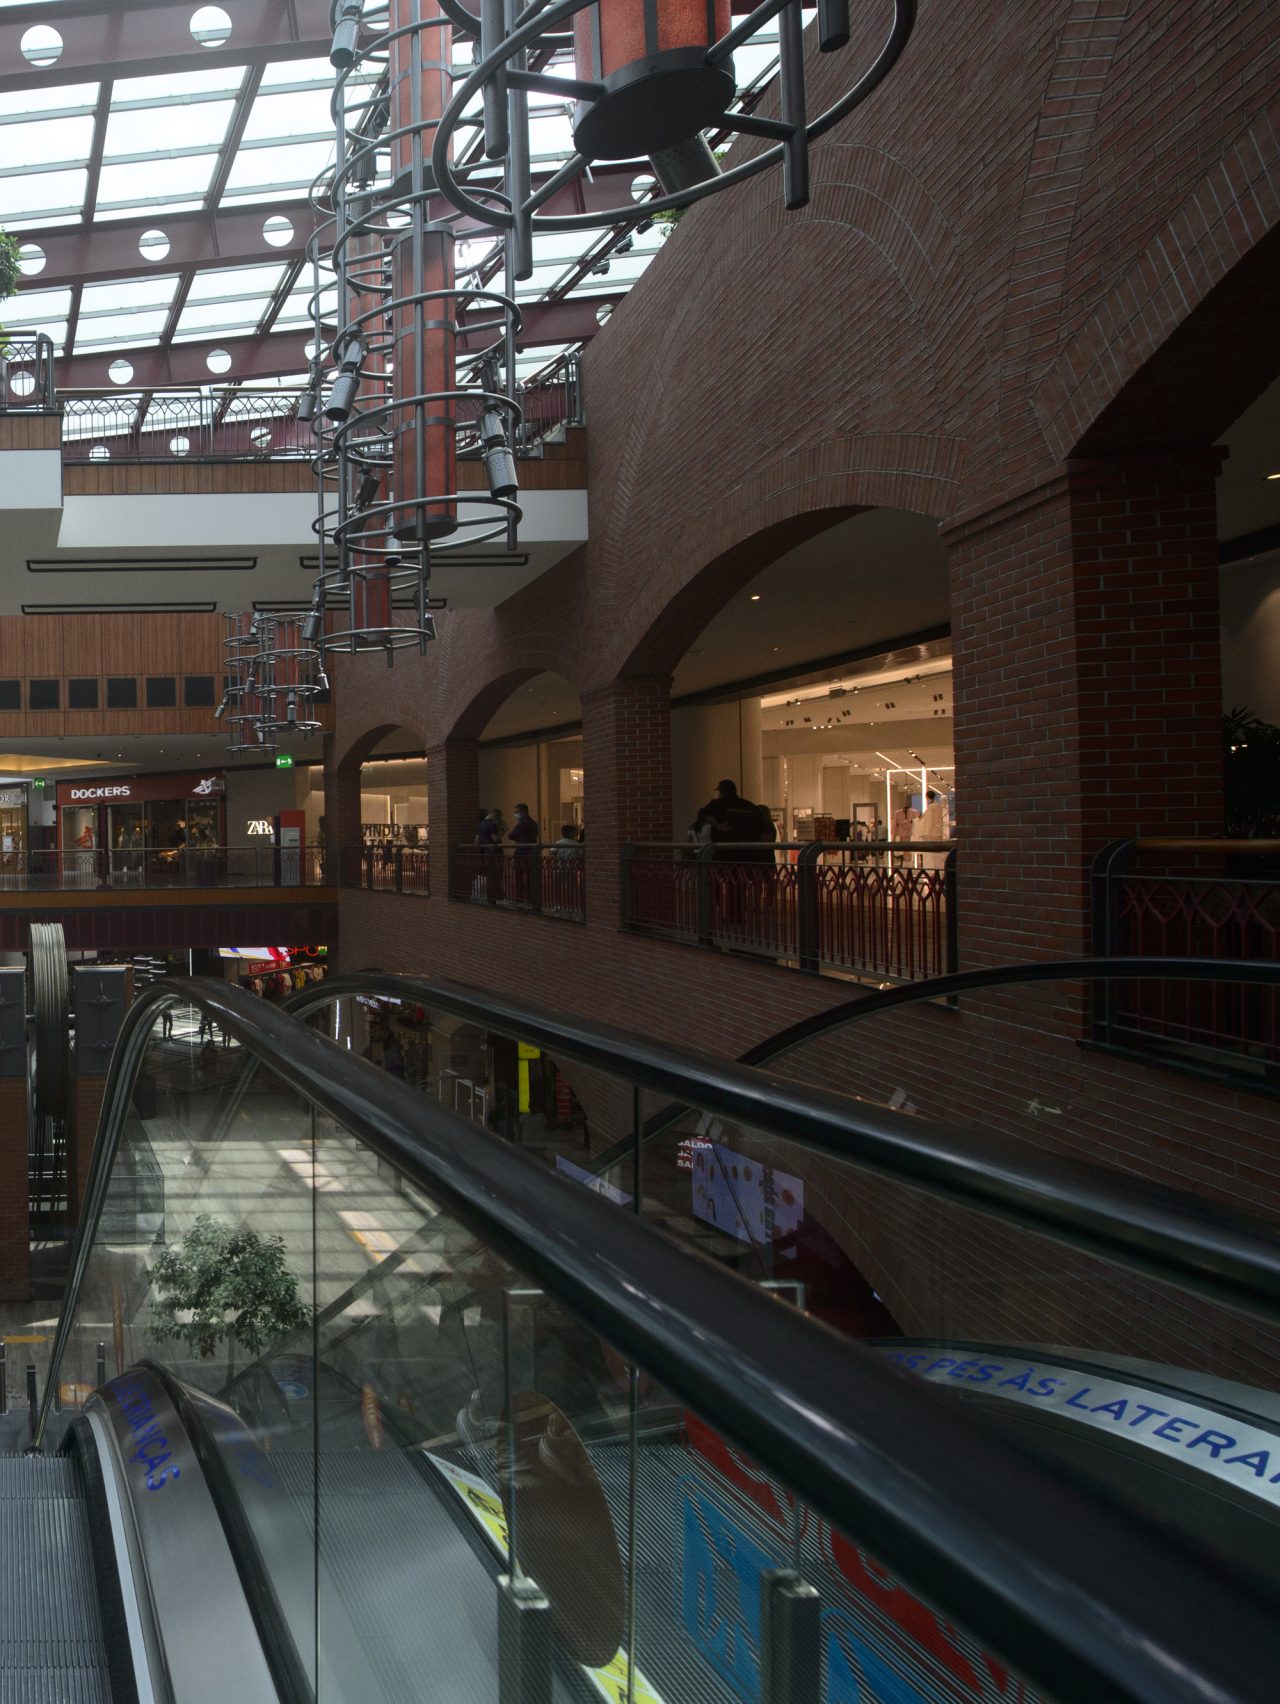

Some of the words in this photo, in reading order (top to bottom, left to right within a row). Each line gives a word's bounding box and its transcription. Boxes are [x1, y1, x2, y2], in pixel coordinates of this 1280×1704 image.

[71, 786, 131, 799] DOCKERS
[923, 1357, 1004, 1383] PÉS
[998, 1366, 1067, 1397] ÀS
[1065, 1387, 1280, 1484] LATERA
